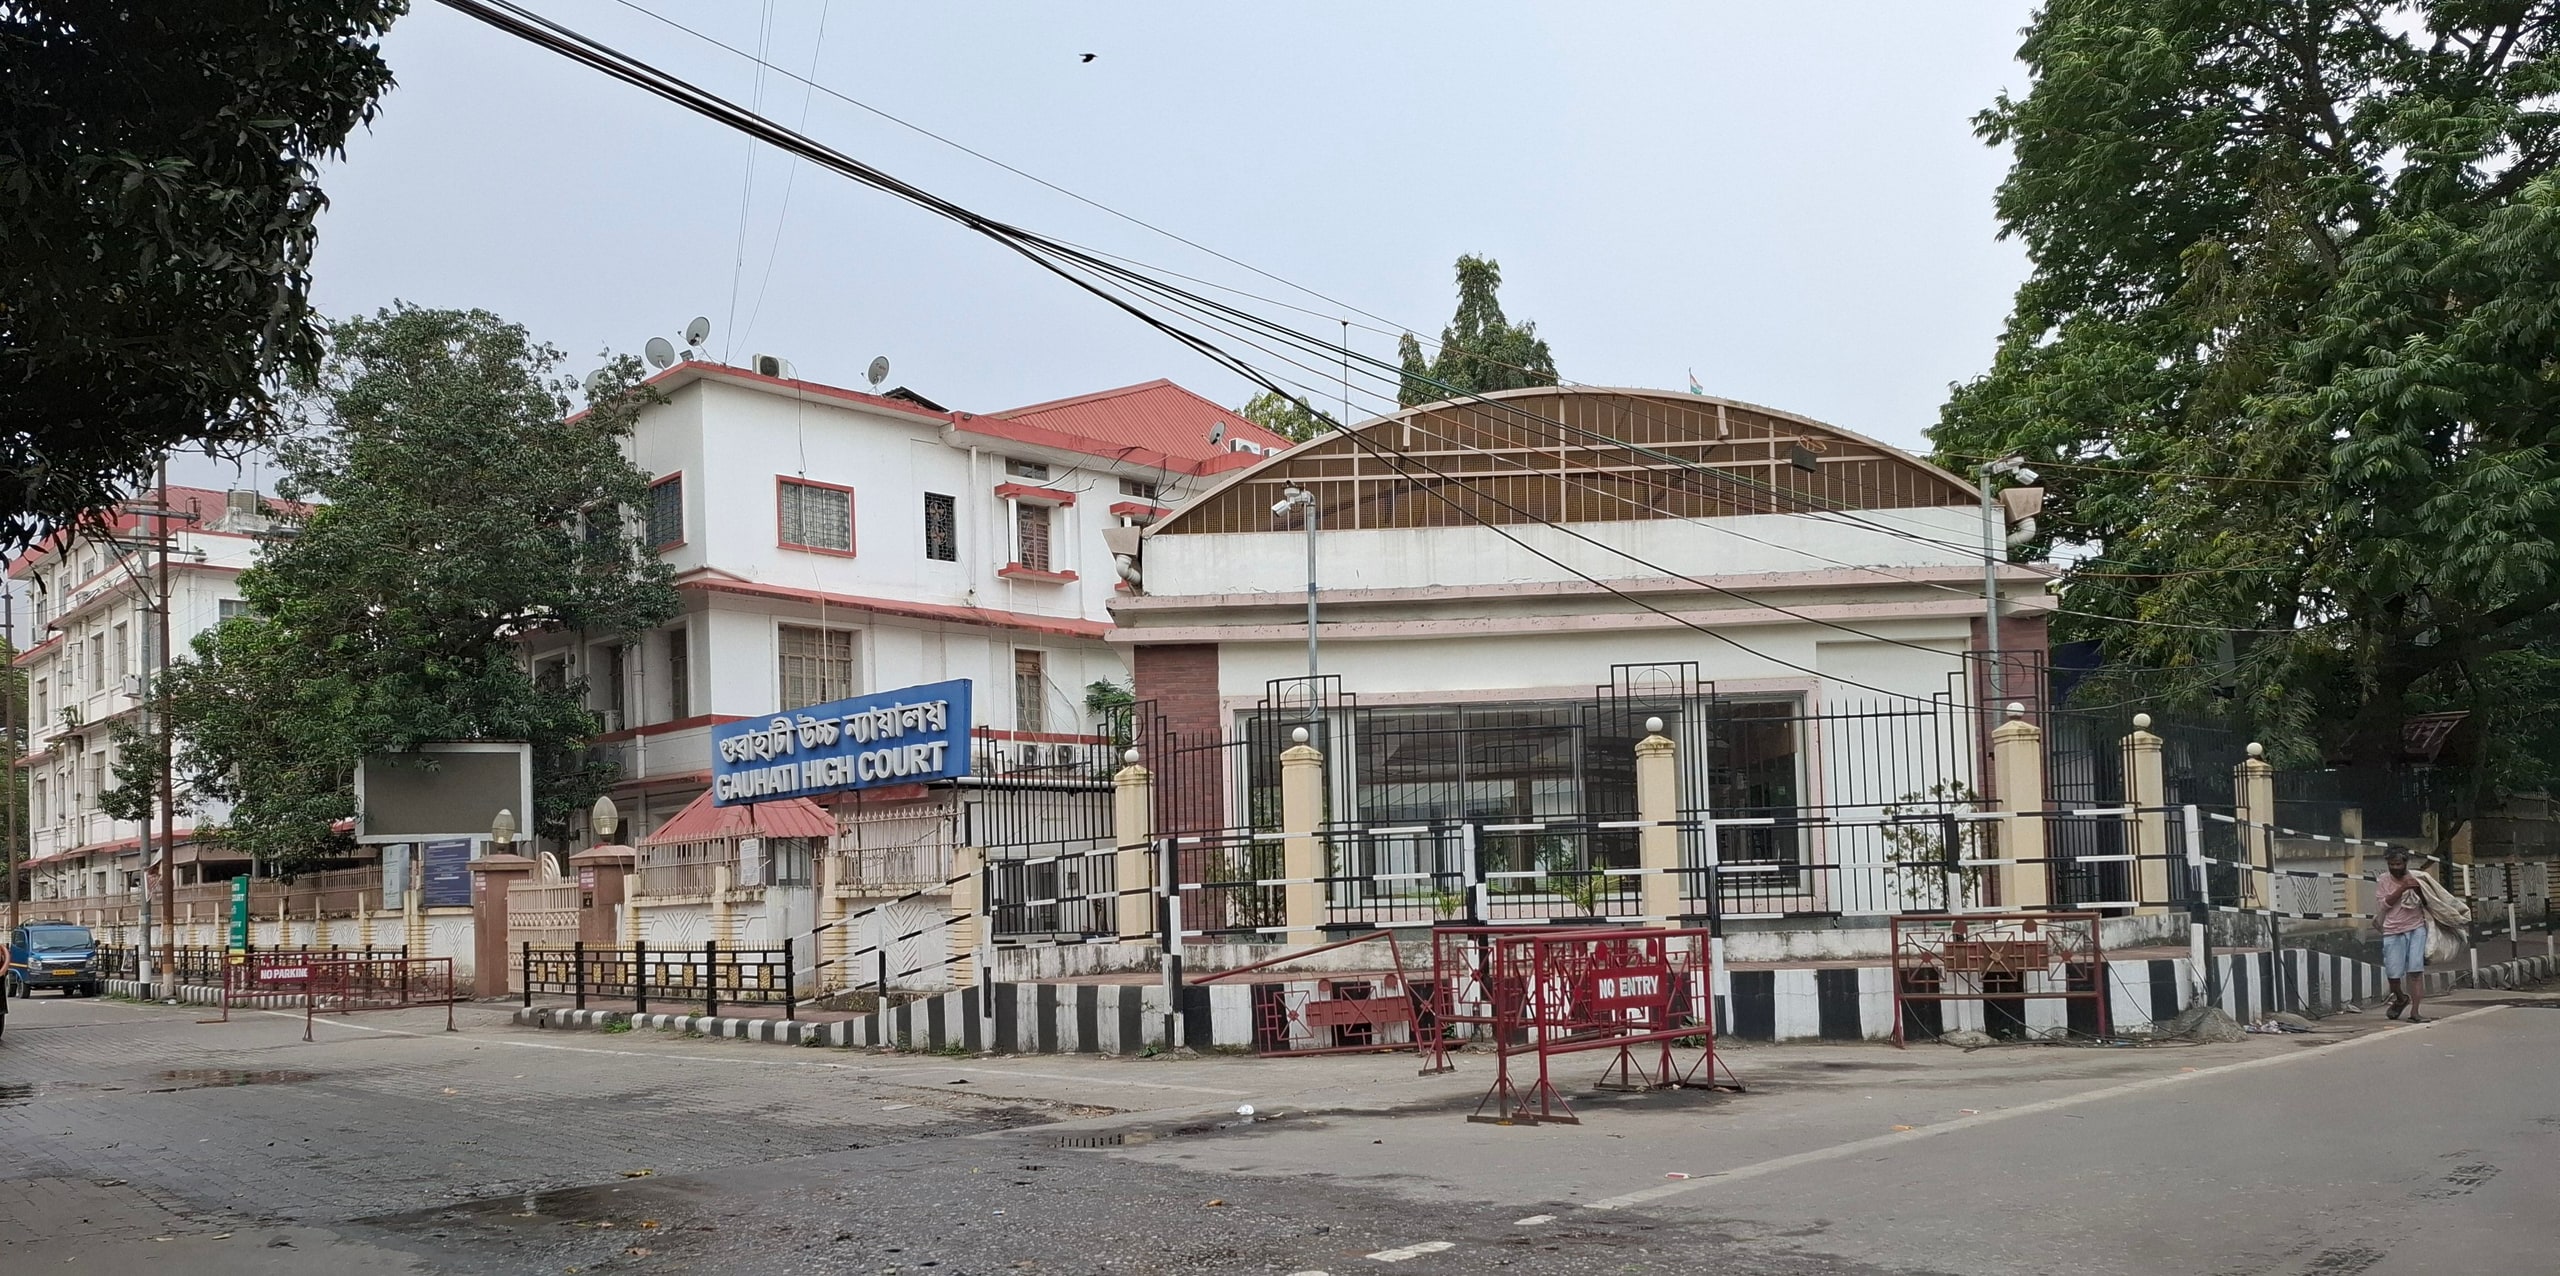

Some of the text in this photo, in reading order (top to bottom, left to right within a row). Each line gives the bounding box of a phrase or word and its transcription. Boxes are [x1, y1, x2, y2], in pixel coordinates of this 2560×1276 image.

[796, 714, 841, 749] উচ্চ
[842, 700, 948, 743] ন্যায়ালয়
[716, 741, 949, 801] GAUHATI HIGH COURT
[260, 969, 273, 980] NO
[1598, 975, 1659, 999] NO ENTRY
